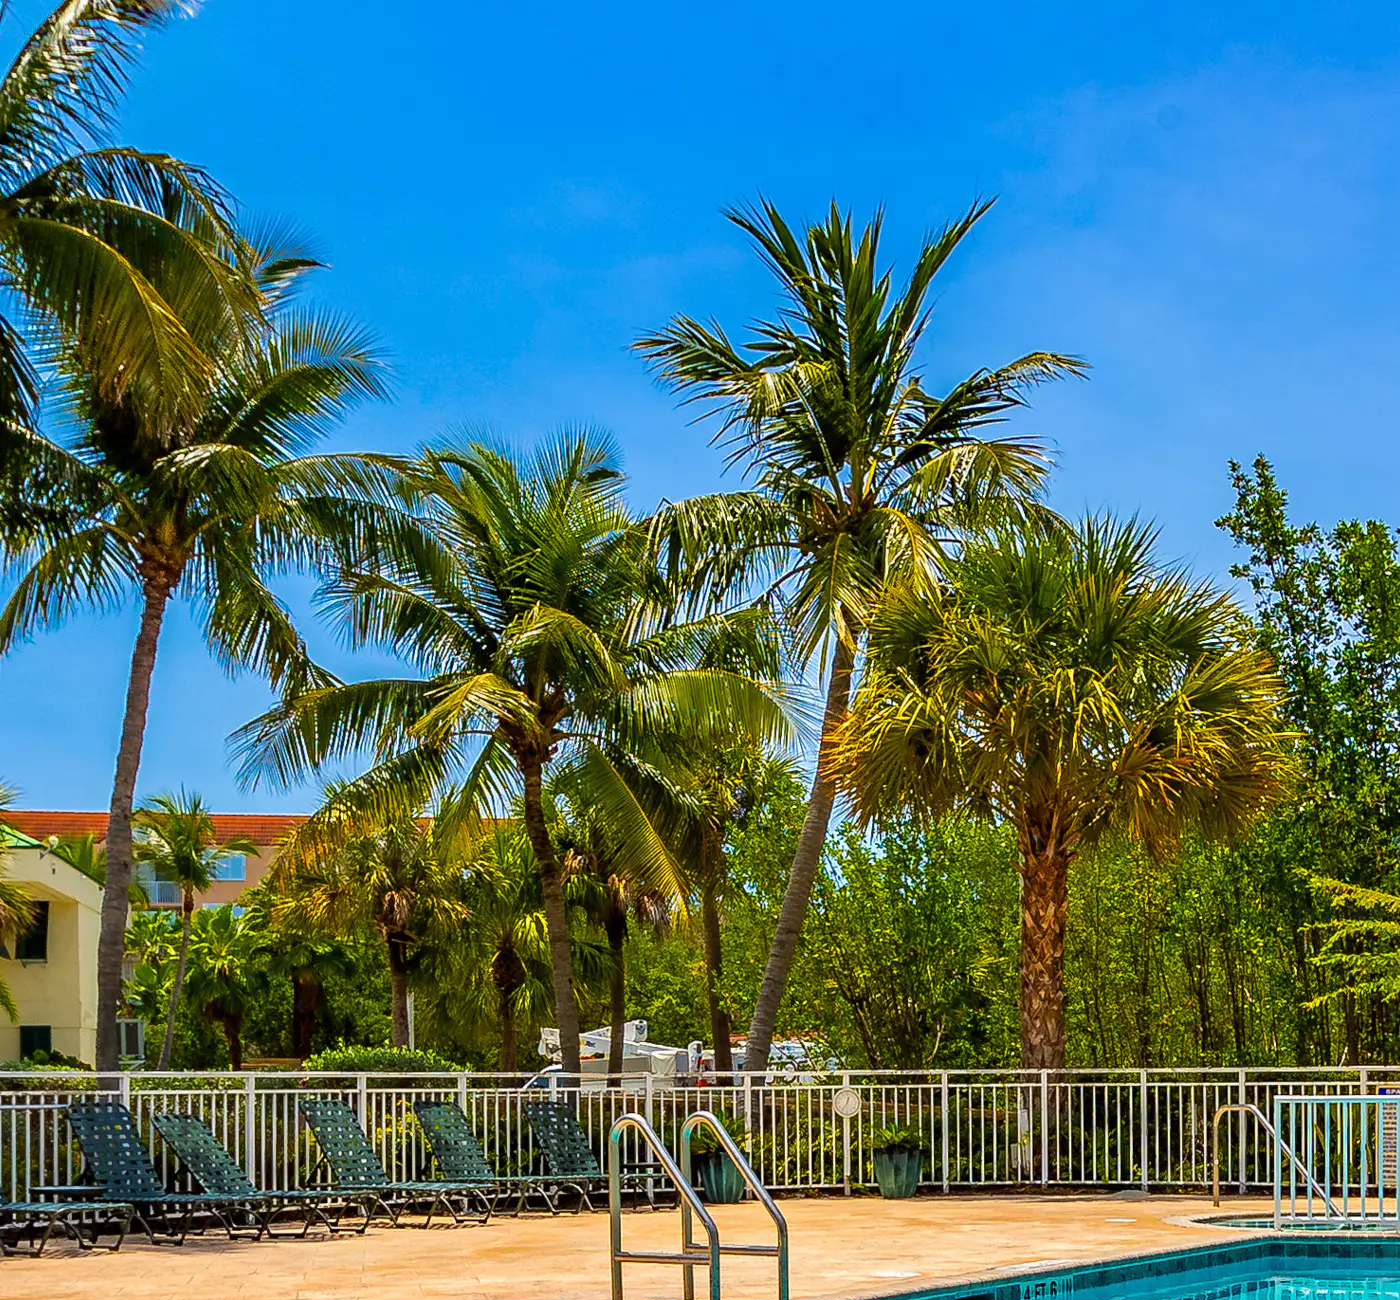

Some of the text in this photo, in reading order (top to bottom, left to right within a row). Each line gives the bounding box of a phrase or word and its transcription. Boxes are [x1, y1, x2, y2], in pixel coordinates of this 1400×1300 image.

[1024, 1278, 1072, 1300] 4 FT 6 IN
